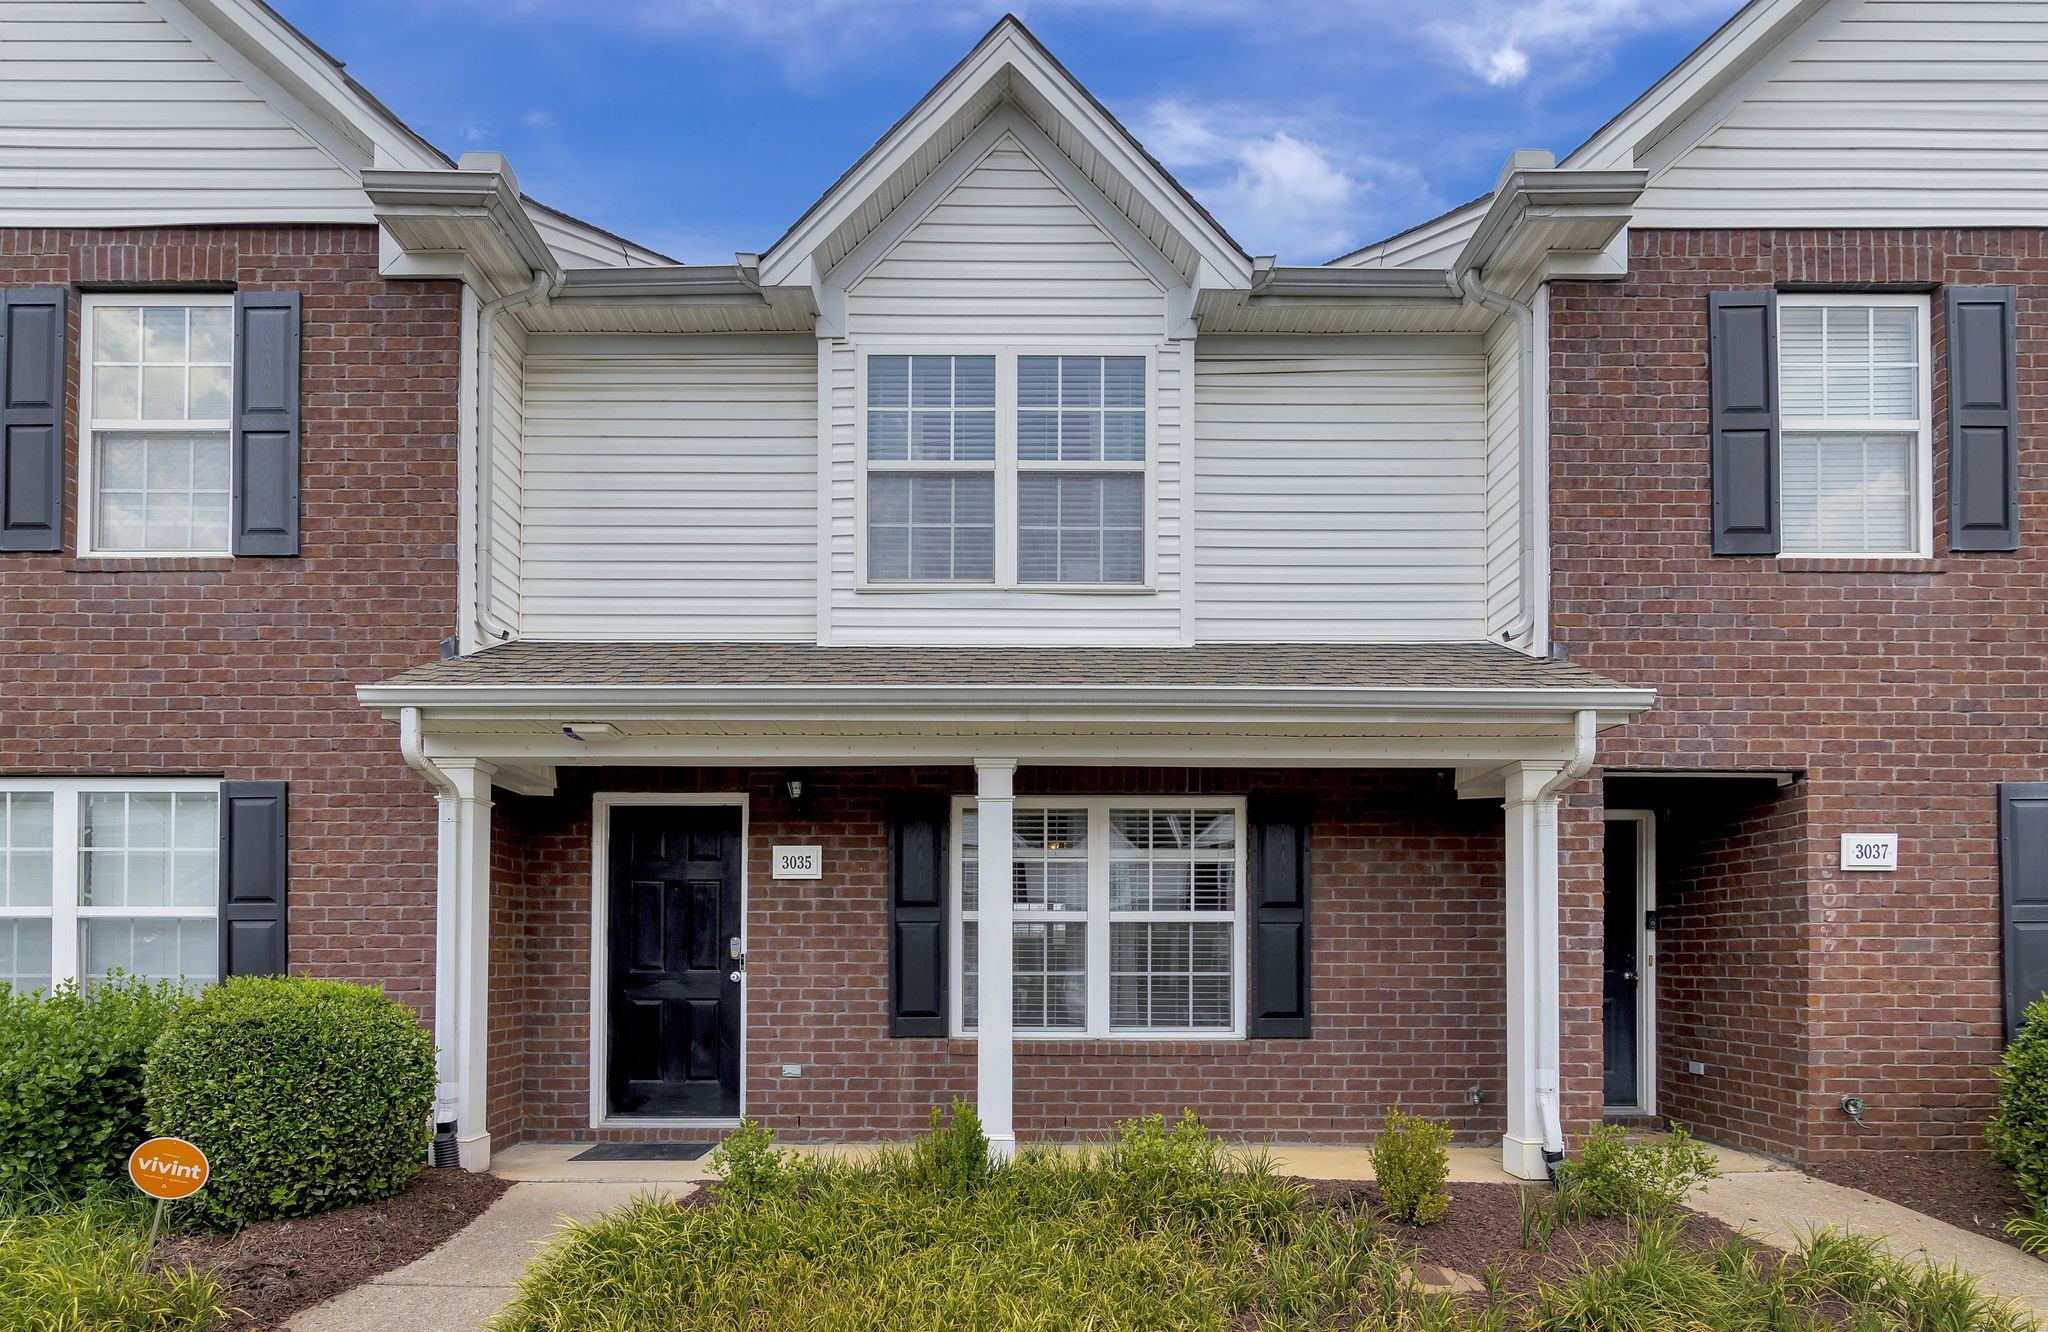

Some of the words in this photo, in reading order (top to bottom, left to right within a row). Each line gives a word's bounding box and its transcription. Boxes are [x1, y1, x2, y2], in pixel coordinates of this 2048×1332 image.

[1855, 843, 1889, 859] 3037
[782, 855, 812, 870] 3035
[138, 1156, 202, 1180] vivint
